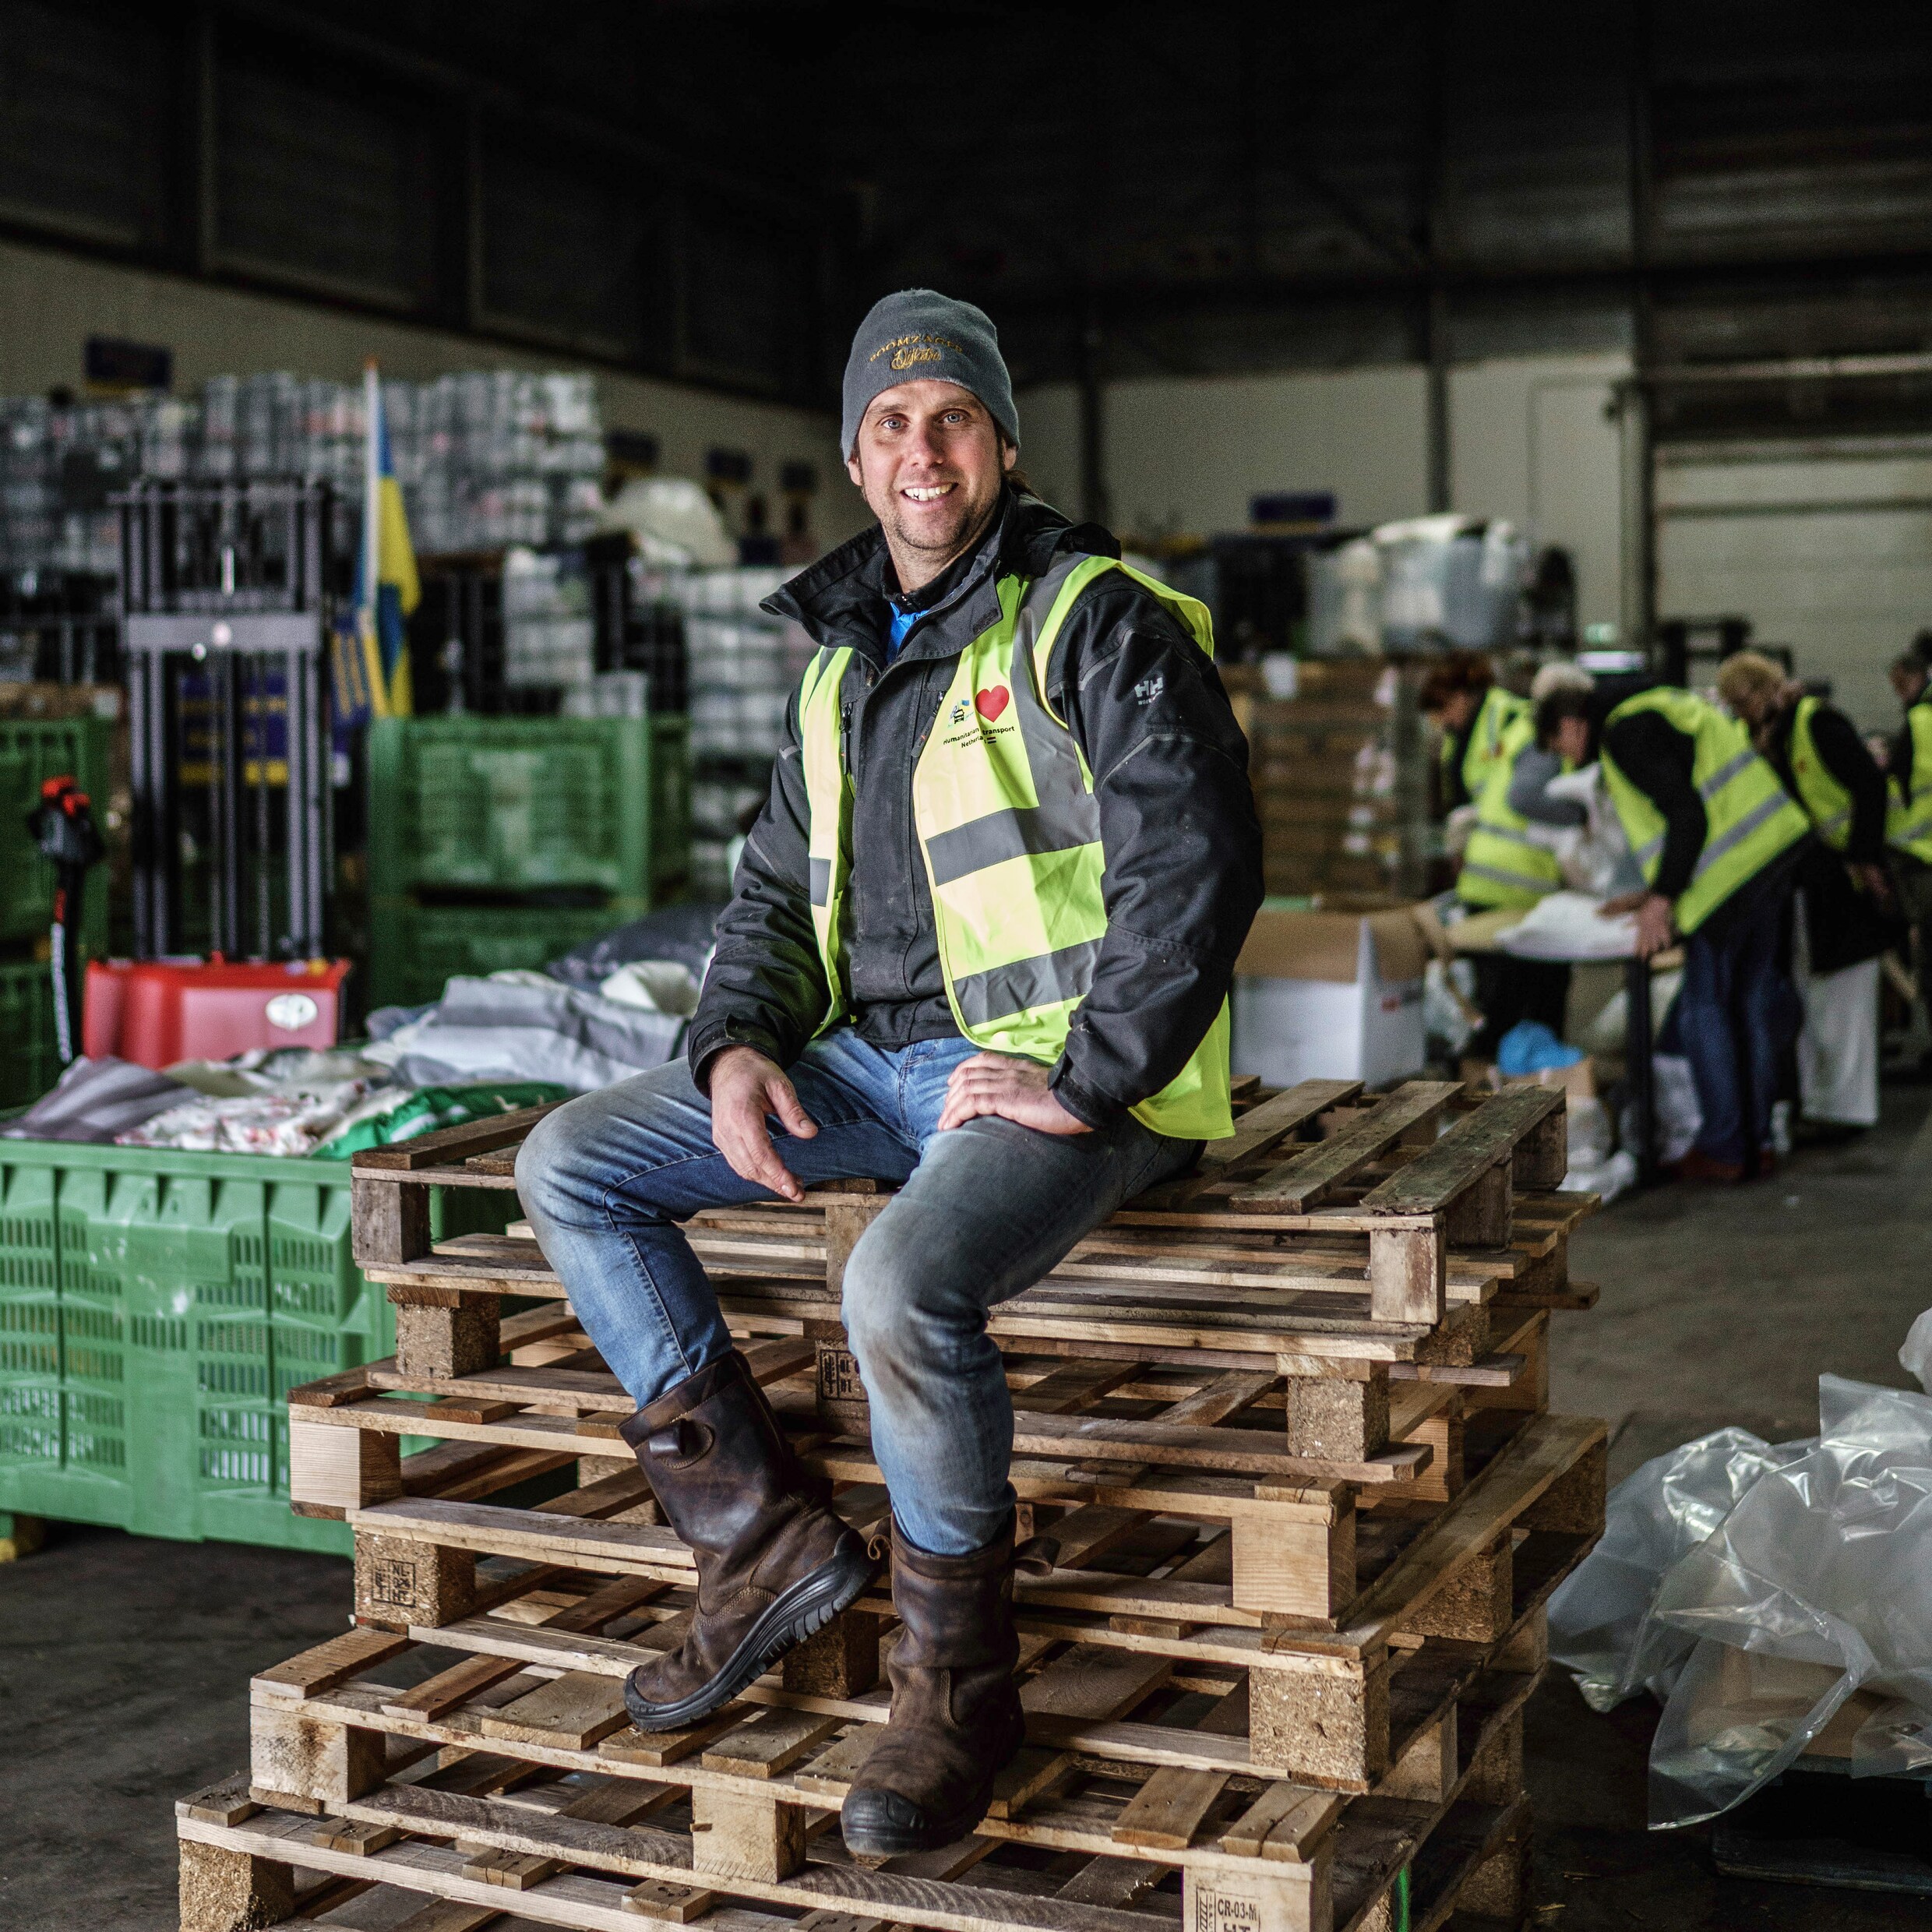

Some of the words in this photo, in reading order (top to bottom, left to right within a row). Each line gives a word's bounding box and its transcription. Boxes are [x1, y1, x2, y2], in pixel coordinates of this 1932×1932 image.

[890, 347, 942, 370] Dijkstra
[1134, 677, 1163, 697] HH
[943, 728, 979, 745] Humanitarian
[982, 726, 1015, 735] transport
[961, 735, 987, 748] Netherla
